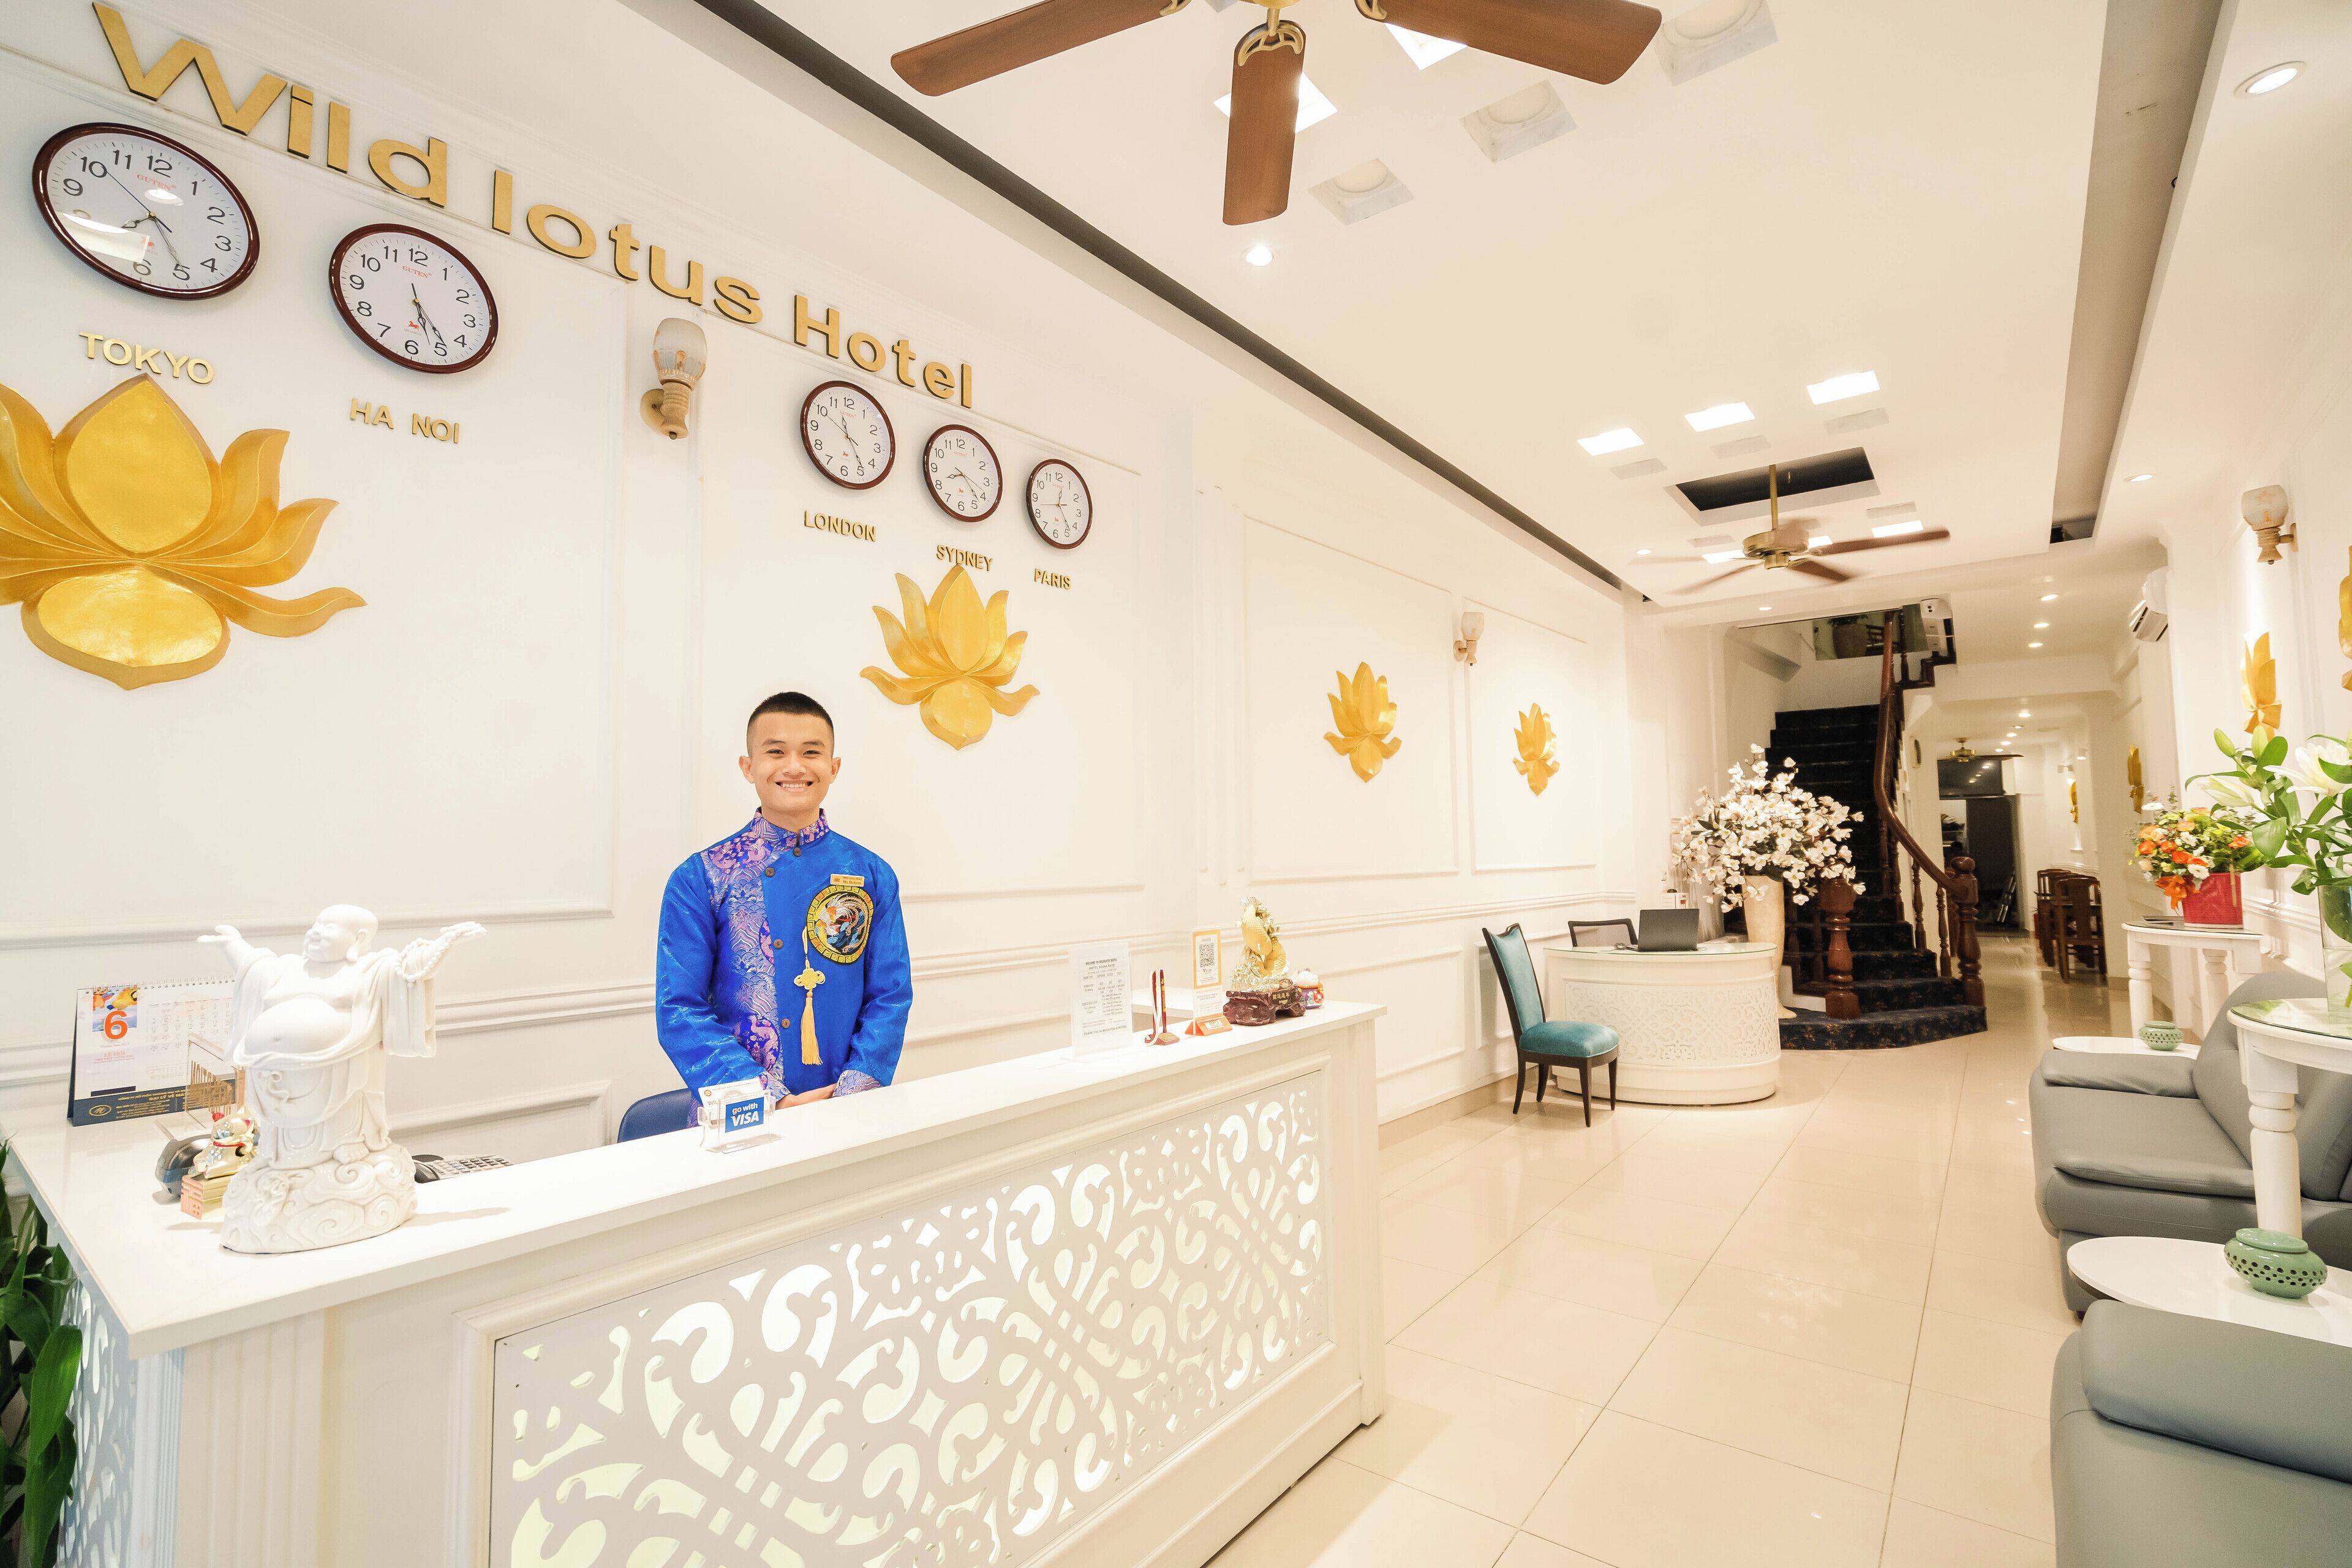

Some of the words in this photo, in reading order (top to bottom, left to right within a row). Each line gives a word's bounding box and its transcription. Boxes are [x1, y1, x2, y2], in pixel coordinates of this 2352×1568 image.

[113, 149, 132, 170] 11
[80, 156, 107, 178] 10
[147, 155, 173, 178] 12
[63, 178, 83, 196] 9
[191, 181, 198, 195] 1
[92, 2, 447, 208] Wild
[492, 169, 763, 324] lotus
[794, 294, 972, 409] Hotel
[207, 206, 225, 225] 2
[215, 235, 232, 252] 3
[383, 246, 398, 263] 11
[408, 248, 428, 267] 12
[200, 258, 217, 273] 4
[360, 254, 380, 271] 10
[172, 263, 190, 281] 5
[402, 265, 428, 279] GUTEN
[442, 268, 447, 281] 1
[350, 274, 364, 290] 9
[456, 289, 469, 304] 2
[357, 301, 372, 317] 8
[464, 314, 476, 328] 3
[377, 323, 391, 337] 7
[454, 334, 467, 347] 4
[405, 340, 418, 355] 6
[434, 342, 447, 356] 5
[79, 331, 214, 384] TOKYO
[829, 396, 837, 409] 11
[843, 397, 854, 410] 12
[816, 404, 827, 417] 10
[862, 409, 865, 419] 1
[350, 398, 394, 430] HA
[412, 413, 460, 443] NOI
[810, 420, 818, 431] 9
[870, 424, 878, 435] 2
[814, 439, 823, 450] 8
[873, 443, 881, 453] 3
[944, 439, 951, 450] 11
[956, 438, 965, 450] 12
[935, 447, 944, 459] 10
[972, 447, 975, 457] 1
[825, 454, 833, 465] 7
[868, 459, 876, 469] 4
[979, 461, 986, 471] 2
[840, 466, 848, 477] 6
[857, 466, 864, 476] 5
[930, 462, 938, 473] 9
[983, 477, 990, 487] 3
[1046, 472, 1051, 482] 11
[1055, 472, 1063, 483] 12
[935, 480, 943, 490] 8
[1036, 479, 1045, 490] 10
[1068, 481, 1071, 489] 1
[944, 492, 951, 502] 7
[980, 492, 986, 501] 4
[1032, 492, 1038, 502] 9
[1073, 493, 1079, 503] 2
[958, 501, 965, 511] 6
[971, 500, 978, 510] 5
[1035, 508, 1041, 518] 8
[1076, 509, 1082, 518] 3
[804, 510, 876, 542] LONDON
[1042, 521, 1048, 530] 7
[1072, 522, 1077, 530] 4
[1053, 529, 1058, 538] 6
[1064, 529, 1070, 538] 5
[937, 545, 993, 571] SYDNEY
[1034, 568, 1071, 590] PARIS
[104, 1011, 128, 1039] 6
[732, 1107, 742, 1115] go
[742, 1102, 758, 1112] with
[731, 1111, 759, 1127] VISA
